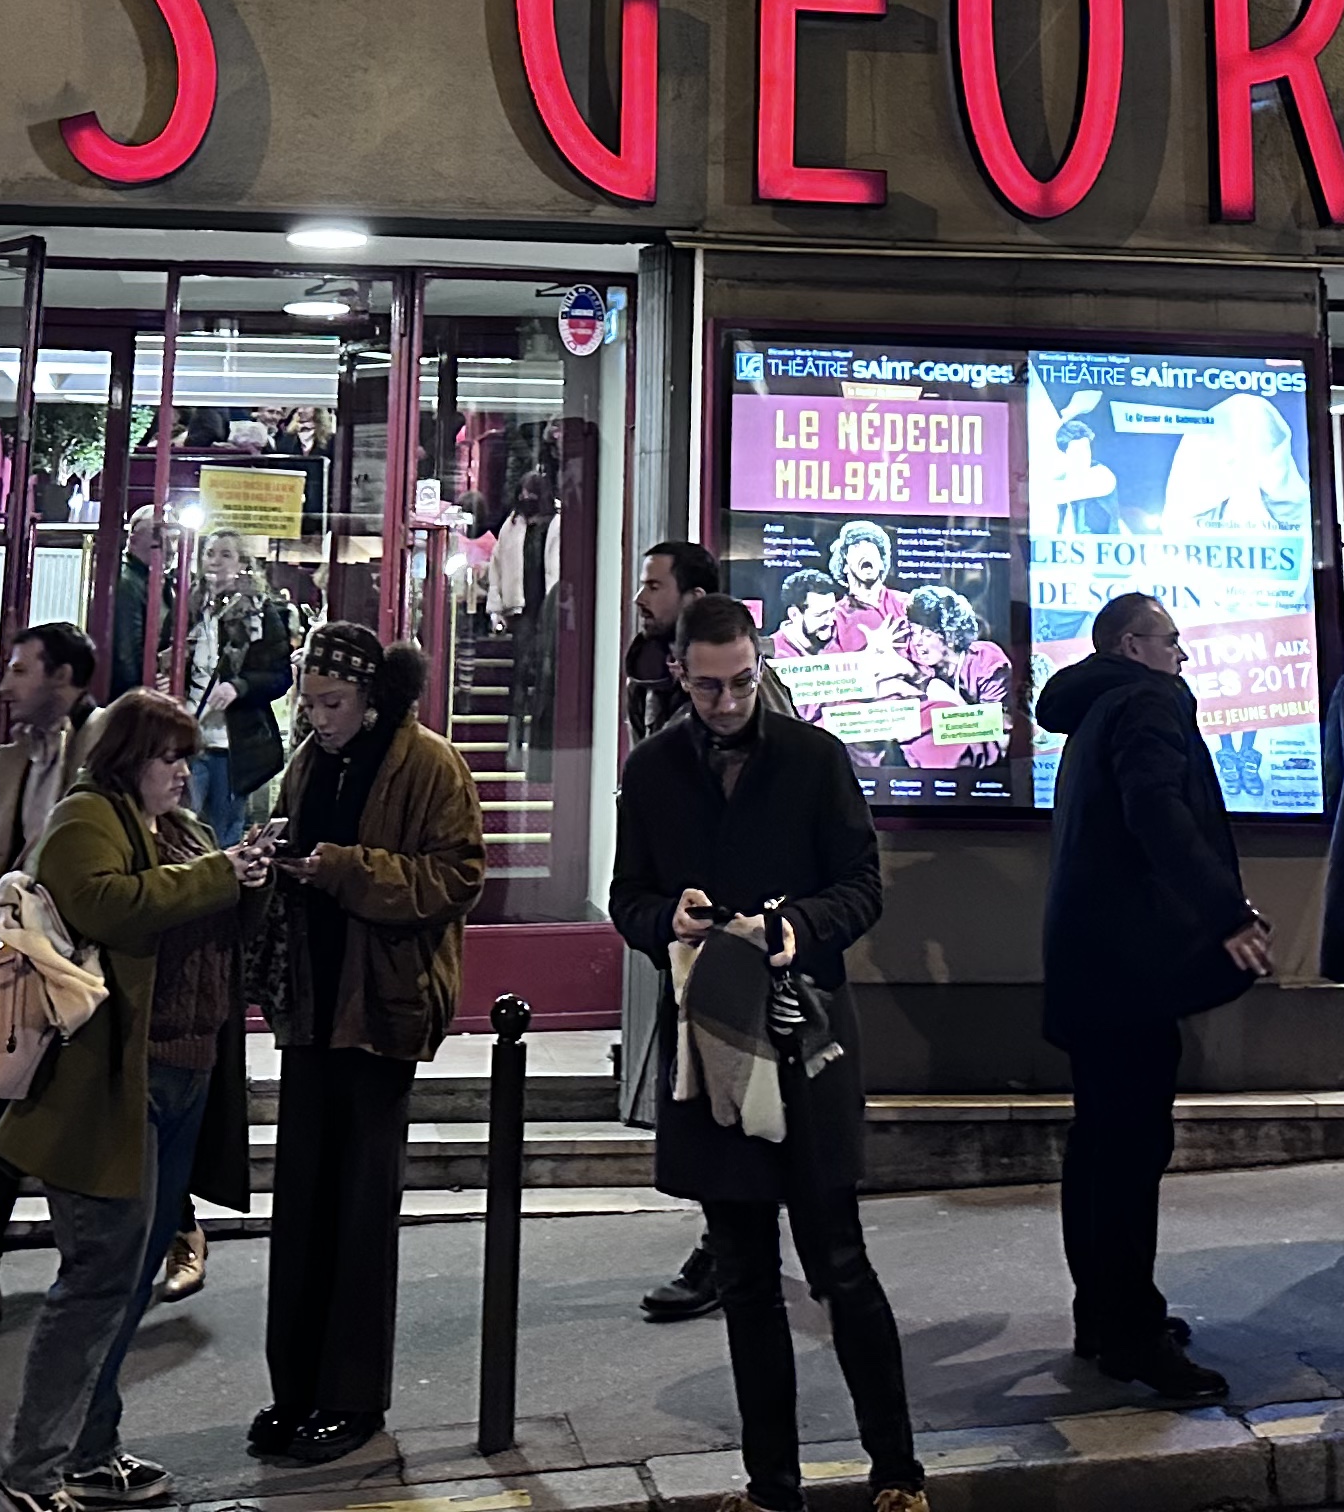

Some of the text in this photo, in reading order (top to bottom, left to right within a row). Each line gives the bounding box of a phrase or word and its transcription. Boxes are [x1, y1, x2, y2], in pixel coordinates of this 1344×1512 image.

[767, 356, 849, 377] THÉÂTRE
[1038, 363, 1126, 386] THÉÂTRE
[928, 464, 983, 504] LUI
[1030, 540, 1085, 564] LES
[1039, 581, 1077, 605] DE
[1274, 639, 1311, 658] AUX
[1248, 661, 1312, 694] 2017
[1225, 705, 1267, 726] JEUNE
[1269, 700, 1317, 718] PUBLIC
